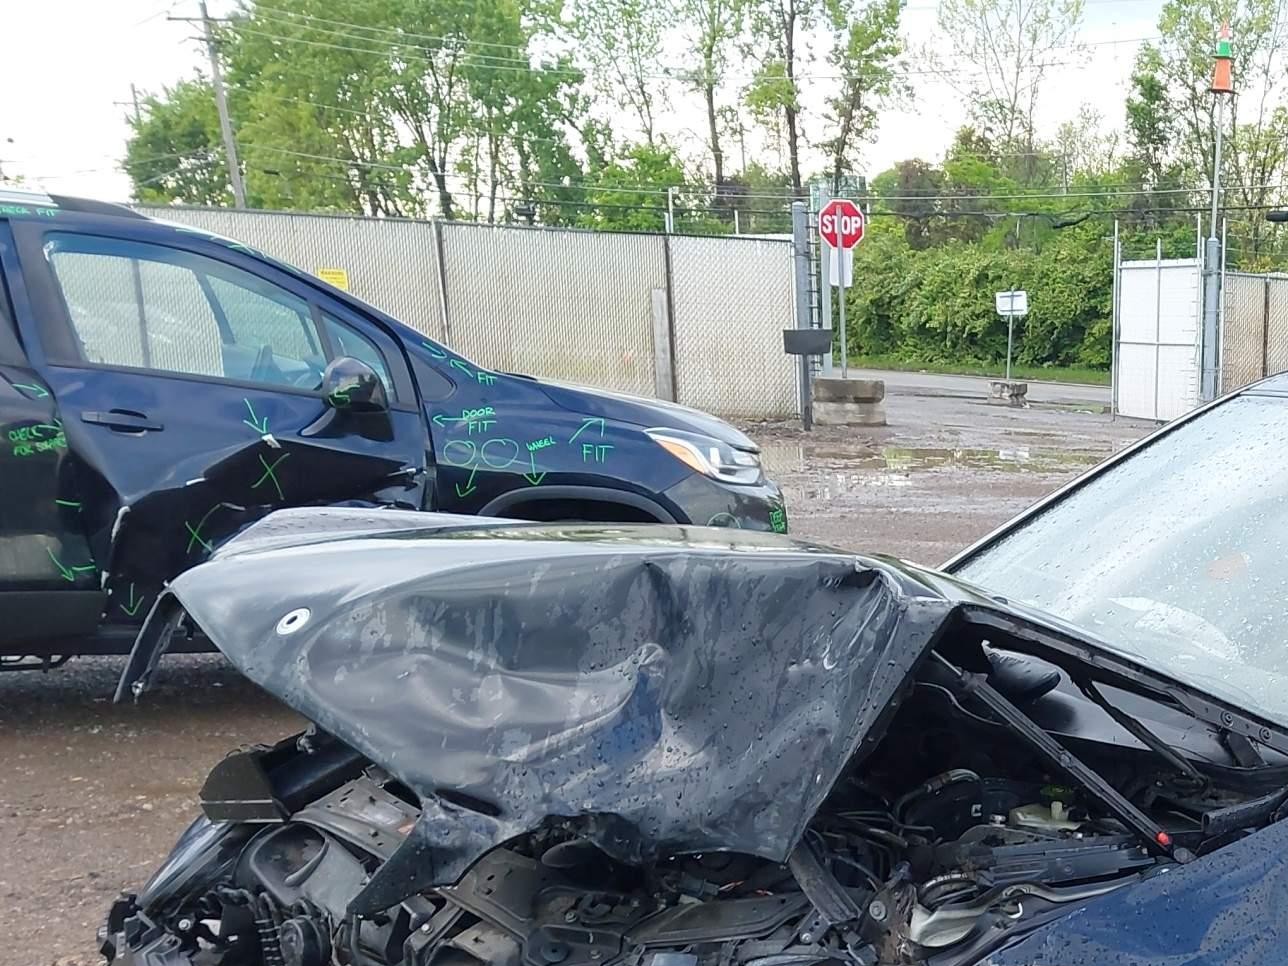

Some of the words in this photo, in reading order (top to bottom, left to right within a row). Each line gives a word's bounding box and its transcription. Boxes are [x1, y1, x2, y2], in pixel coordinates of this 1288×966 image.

[822, 215, 861, 235] STOP
[476, 372, 498, 386] FIT
[462, 406, 496, 420] DOOR
[468, 420, 497, 436] FIT
[526, 436, 557, 451] WHEEL
[582, 444, 615, 464] FIT
